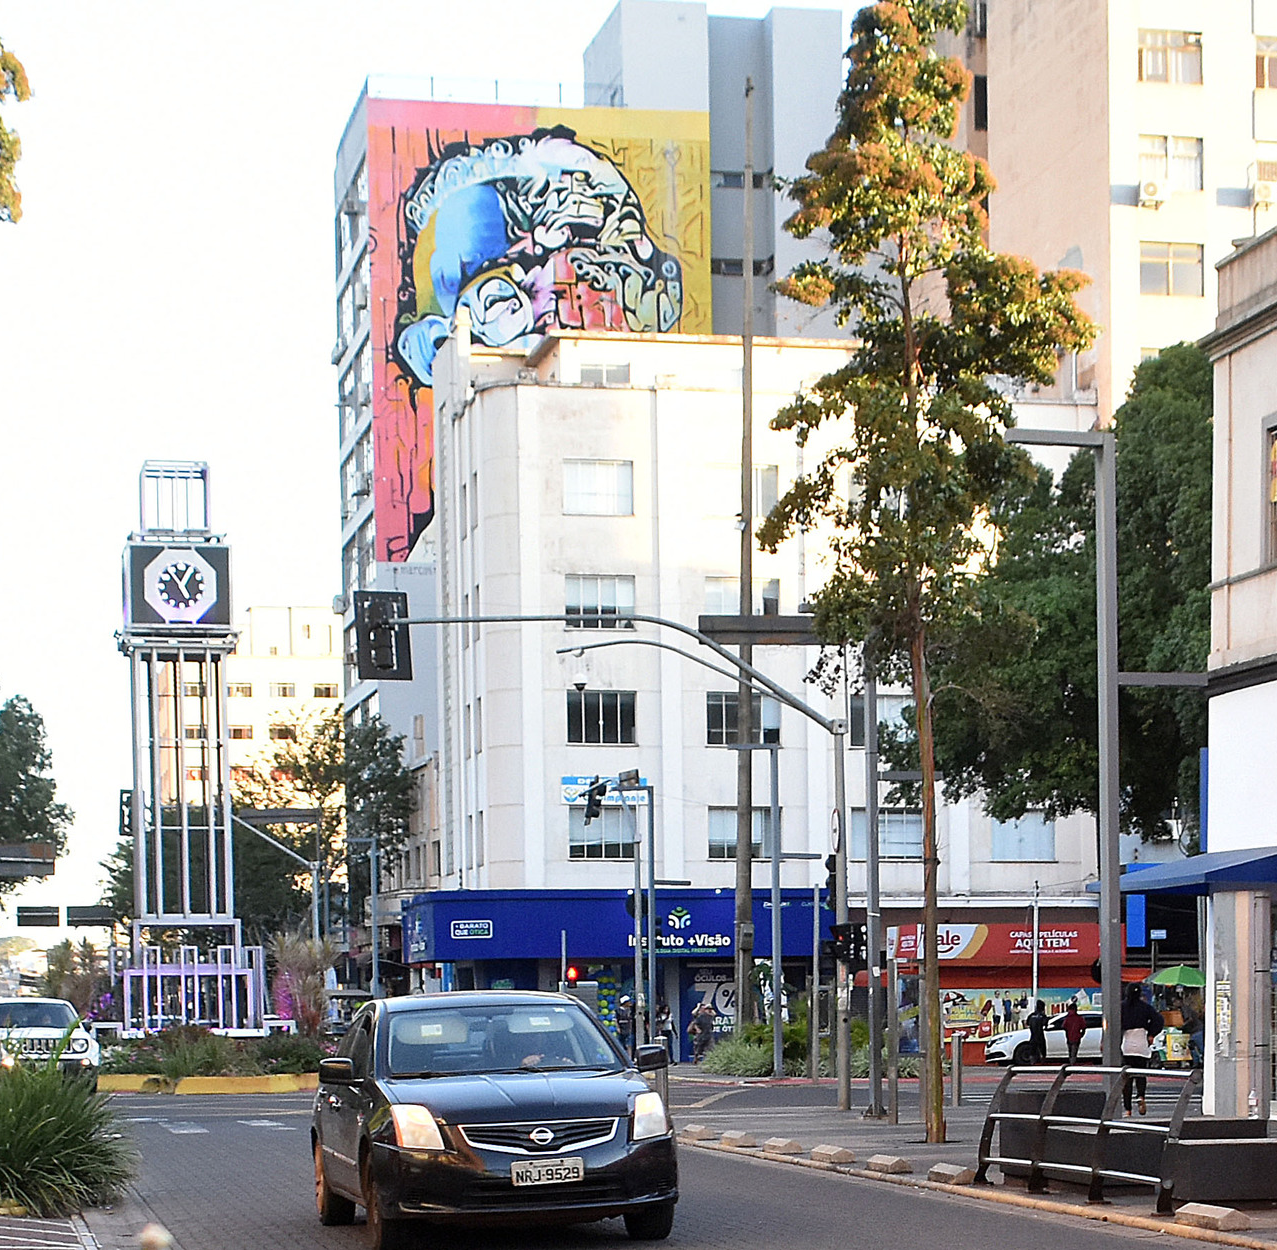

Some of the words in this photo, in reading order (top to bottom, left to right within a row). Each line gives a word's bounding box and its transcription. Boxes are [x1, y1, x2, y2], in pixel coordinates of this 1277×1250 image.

[1015, 938, 1044, 949] AQI
[1045, 938, 1070, 947] TEM
[516, 1167, 579, 1183] NRJ-9529
